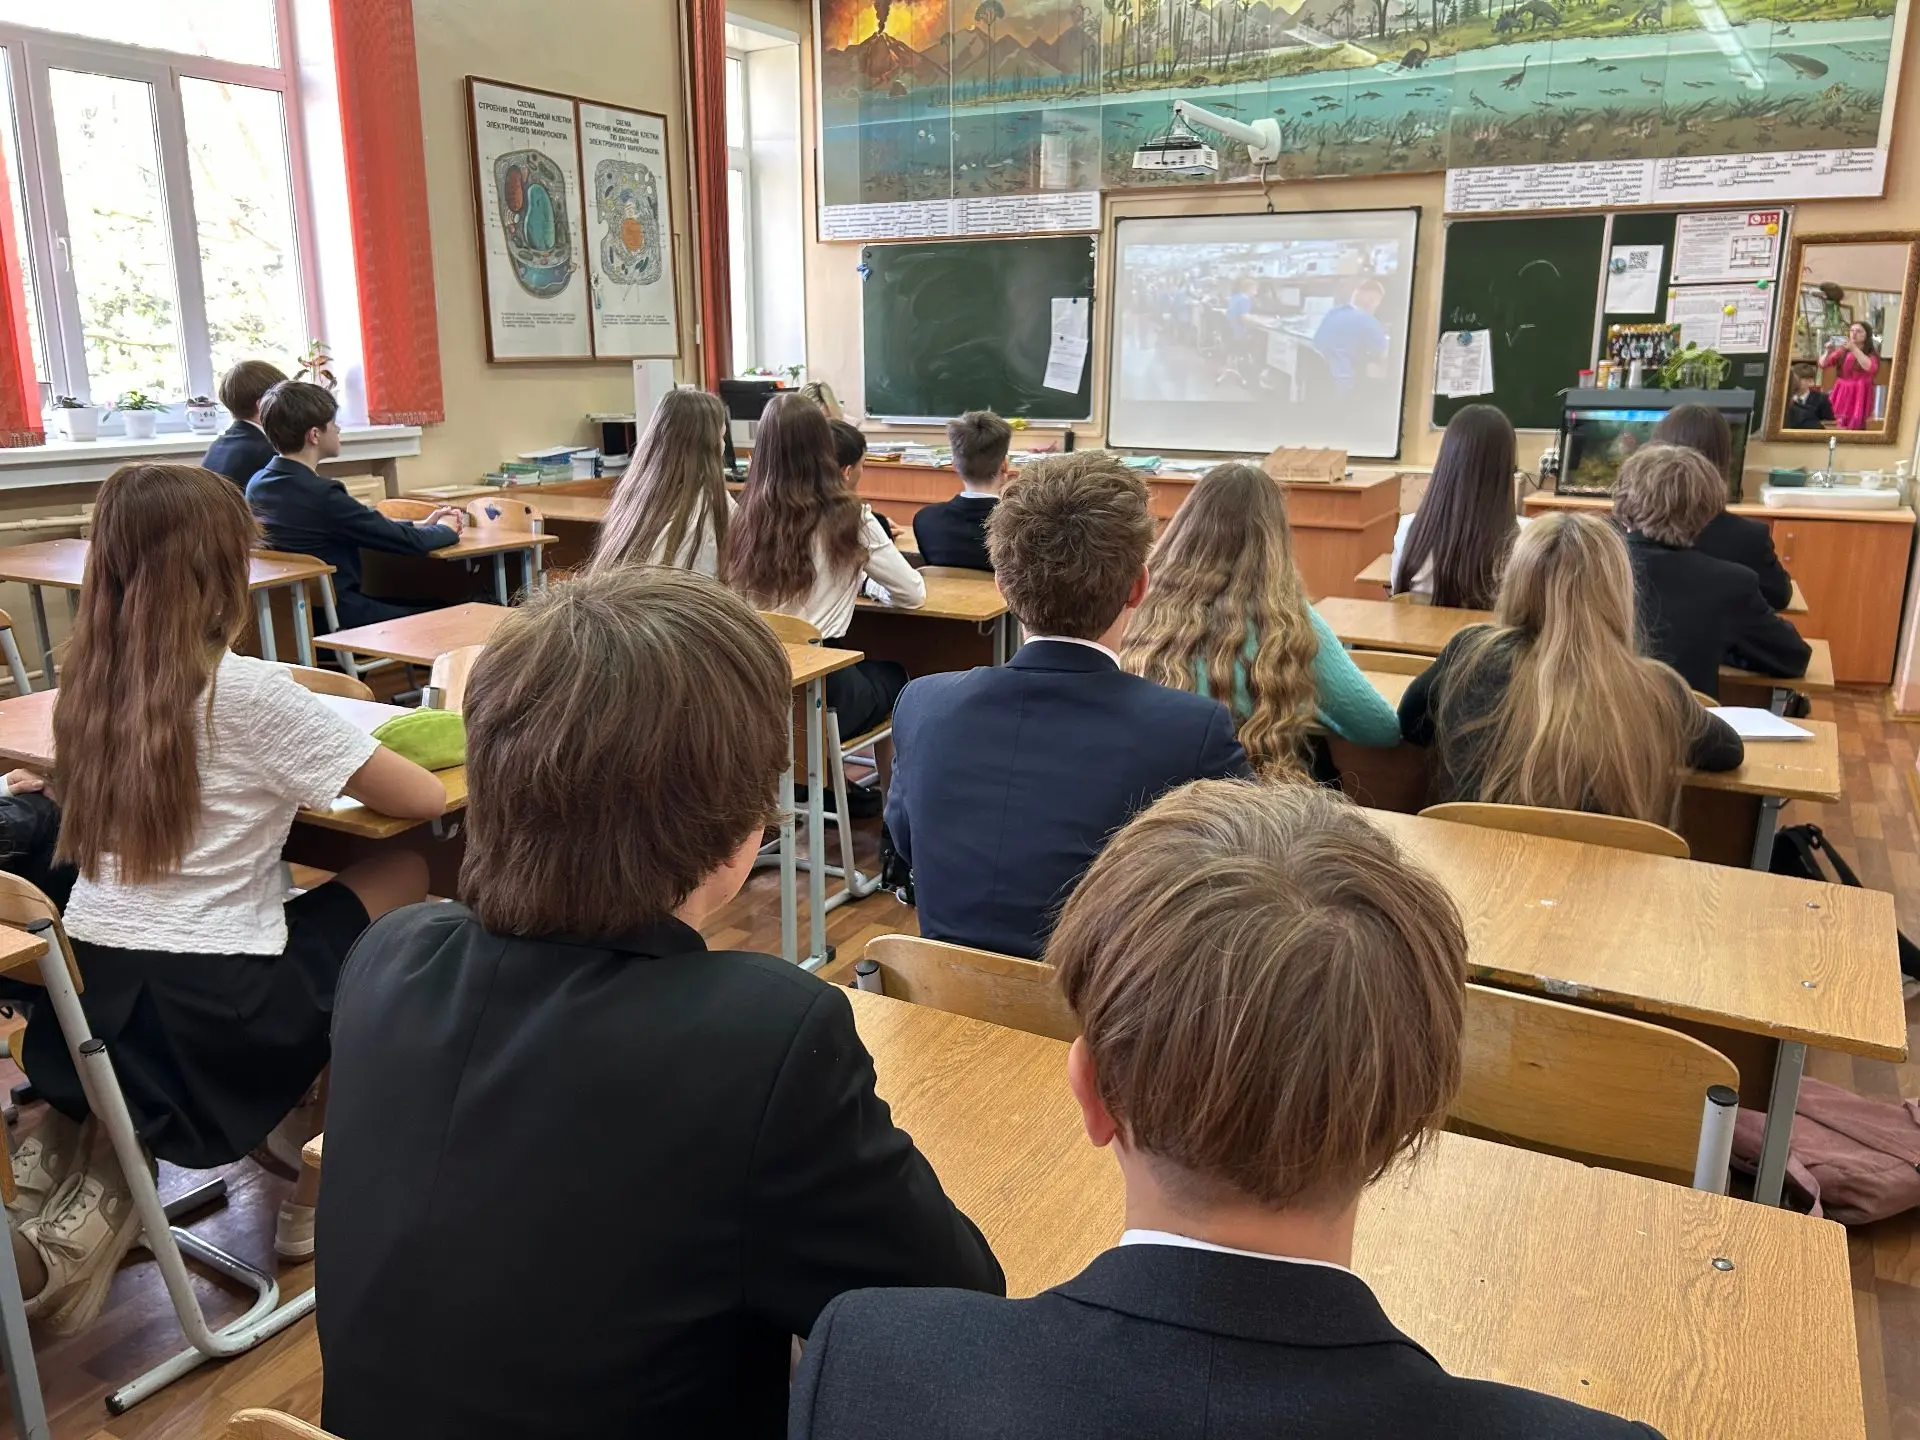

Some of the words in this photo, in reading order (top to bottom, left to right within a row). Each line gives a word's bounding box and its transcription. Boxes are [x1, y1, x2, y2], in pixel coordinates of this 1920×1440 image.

[517, 99, 536, 109] СХЕМА
[479, 101, 508, 113] СТРОЕНИЯ
[509, 107, 550, 121] РАСТИТЕЛЬНОЙ
[551, 114, 573, 124] КЛЕТКИ
[486, 120, 530, 134] ЭЛЕКТРОННОГО
[1760, 213, 1778, 224] 112
